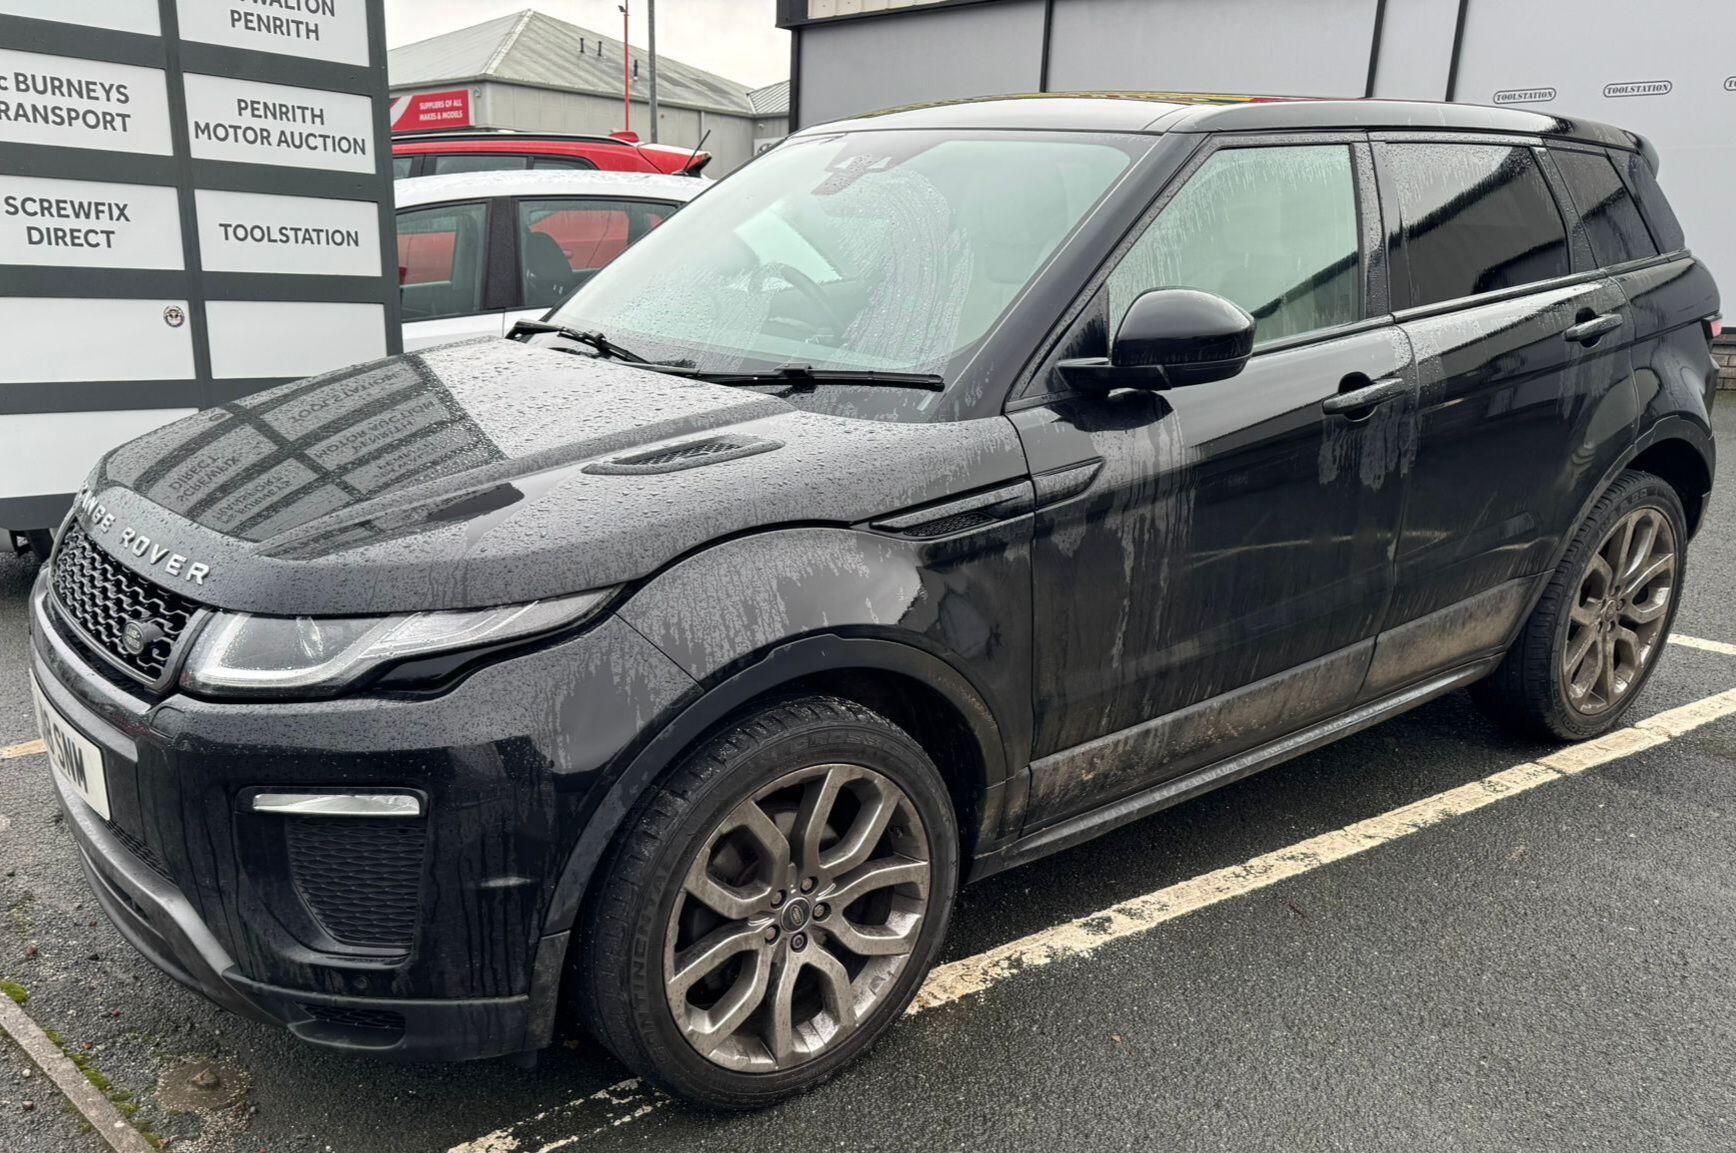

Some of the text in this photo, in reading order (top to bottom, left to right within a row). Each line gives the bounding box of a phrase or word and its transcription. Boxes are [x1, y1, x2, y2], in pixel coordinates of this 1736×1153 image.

[252, 0, 335, 17] LTON
[230, 9, 319, 41] PENRITH
[14, 71, 130, 104] BURNEYS
[1497, 91, 1553, 101] TOOLSTATION
[1607, 84, 1668, 95] TOOLSTATION
[0, 100, 131, 132] RANSPORT
[237, 98, 325, 126] PENRITH
[419, 101, 444, 110] SUPPLIERS
[453, 99, 463, 107] ALL
[419, 113, 437, 121] MAKES
[442, 110, 463, 119] MODELS
[194, 121, 366, 155] MOTOR AUCTION
[4, 195, 130, 222] SCREWFIX
[26, 226, 115, 249] DIRECT
[219, 223, 359, 247] TOOLSTATION
[82, 490, 210, 585] NGE ROVER
